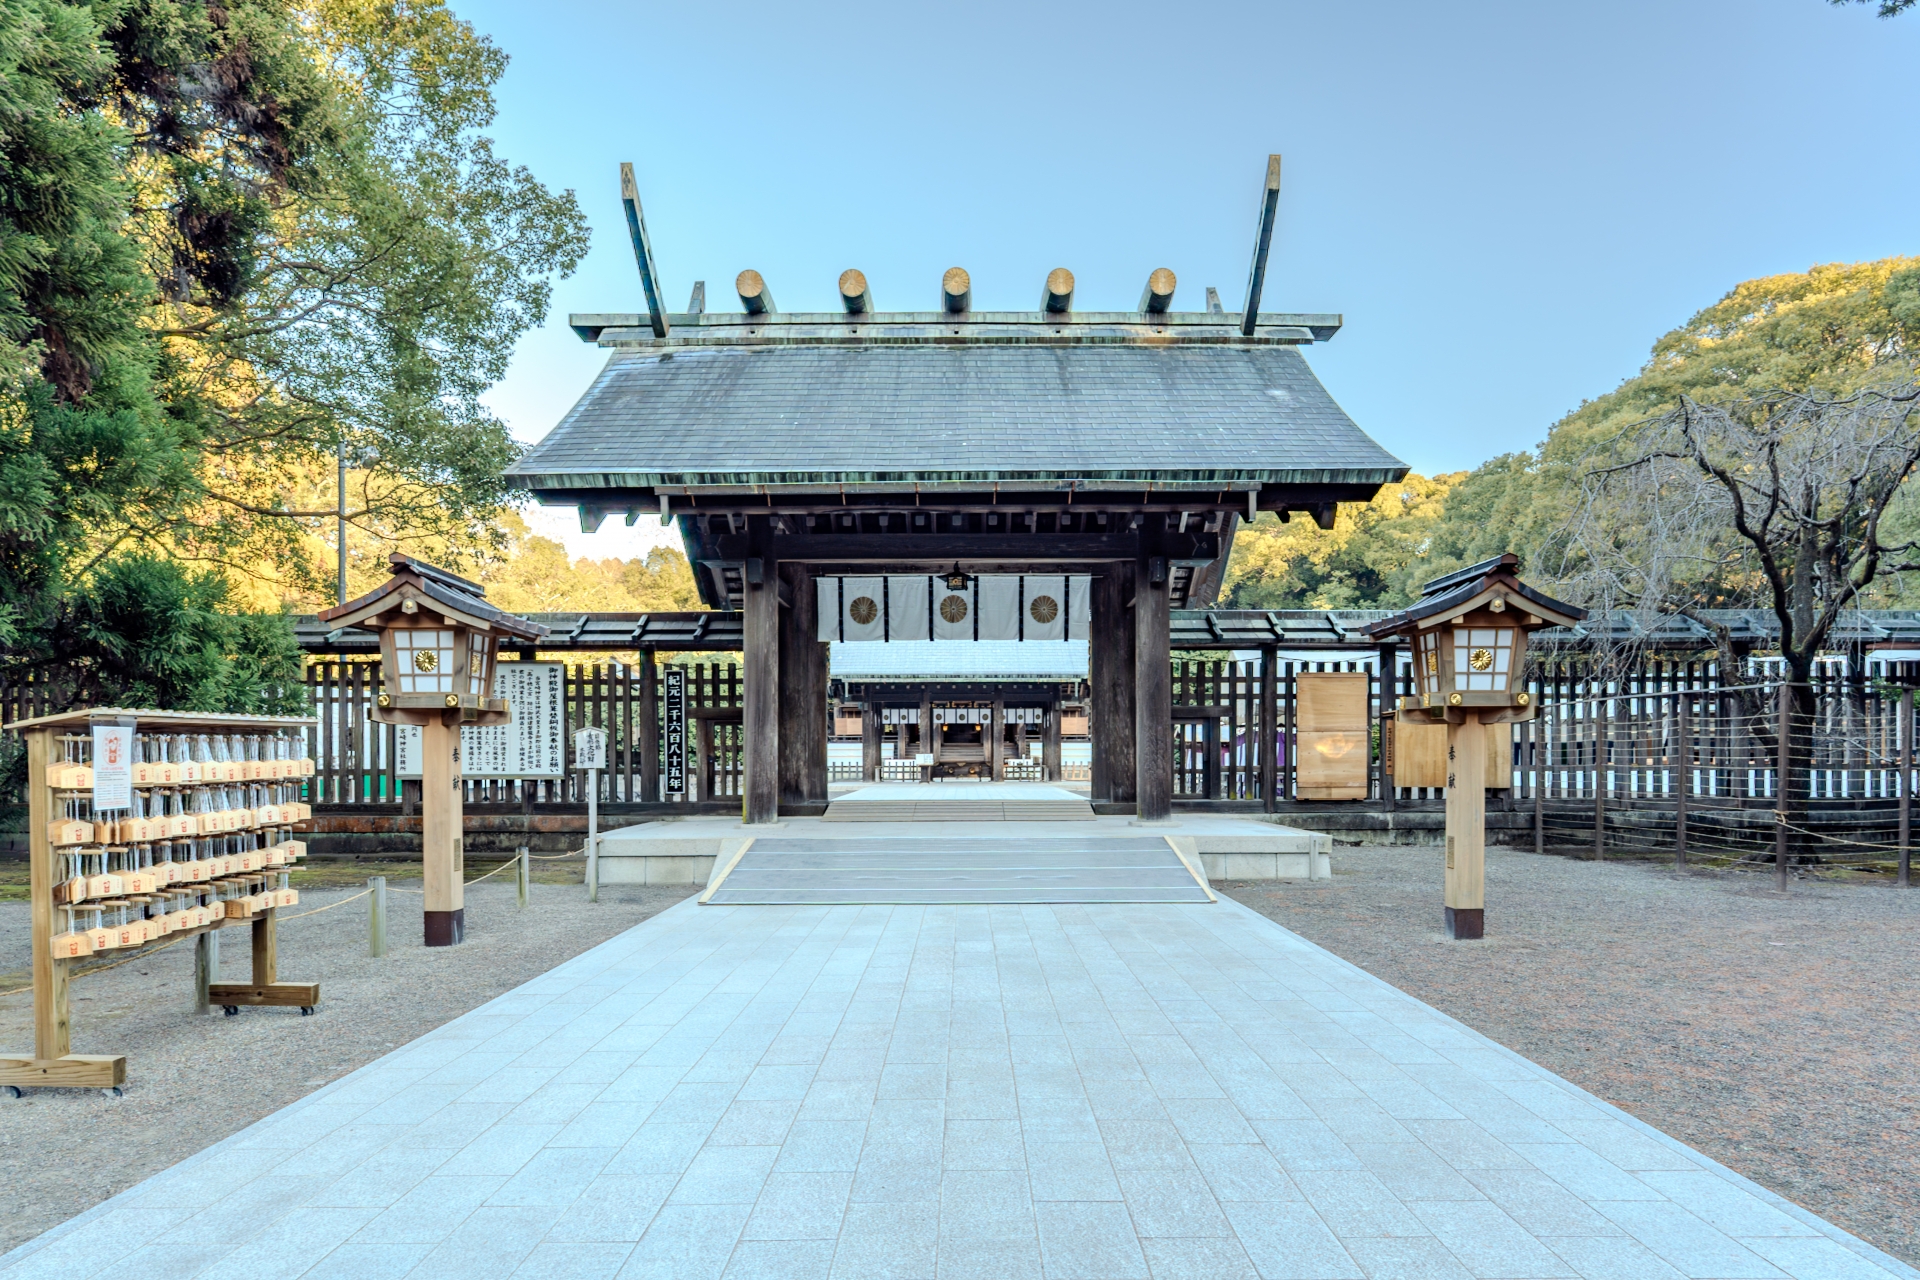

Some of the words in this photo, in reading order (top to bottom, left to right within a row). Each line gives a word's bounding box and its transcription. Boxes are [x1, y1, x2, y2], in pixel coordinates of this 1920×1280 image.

[399, 728, 407, 771] 宮崎神宮社務所
[668, 675, 682, 789] 紀元二千六百八十五年
